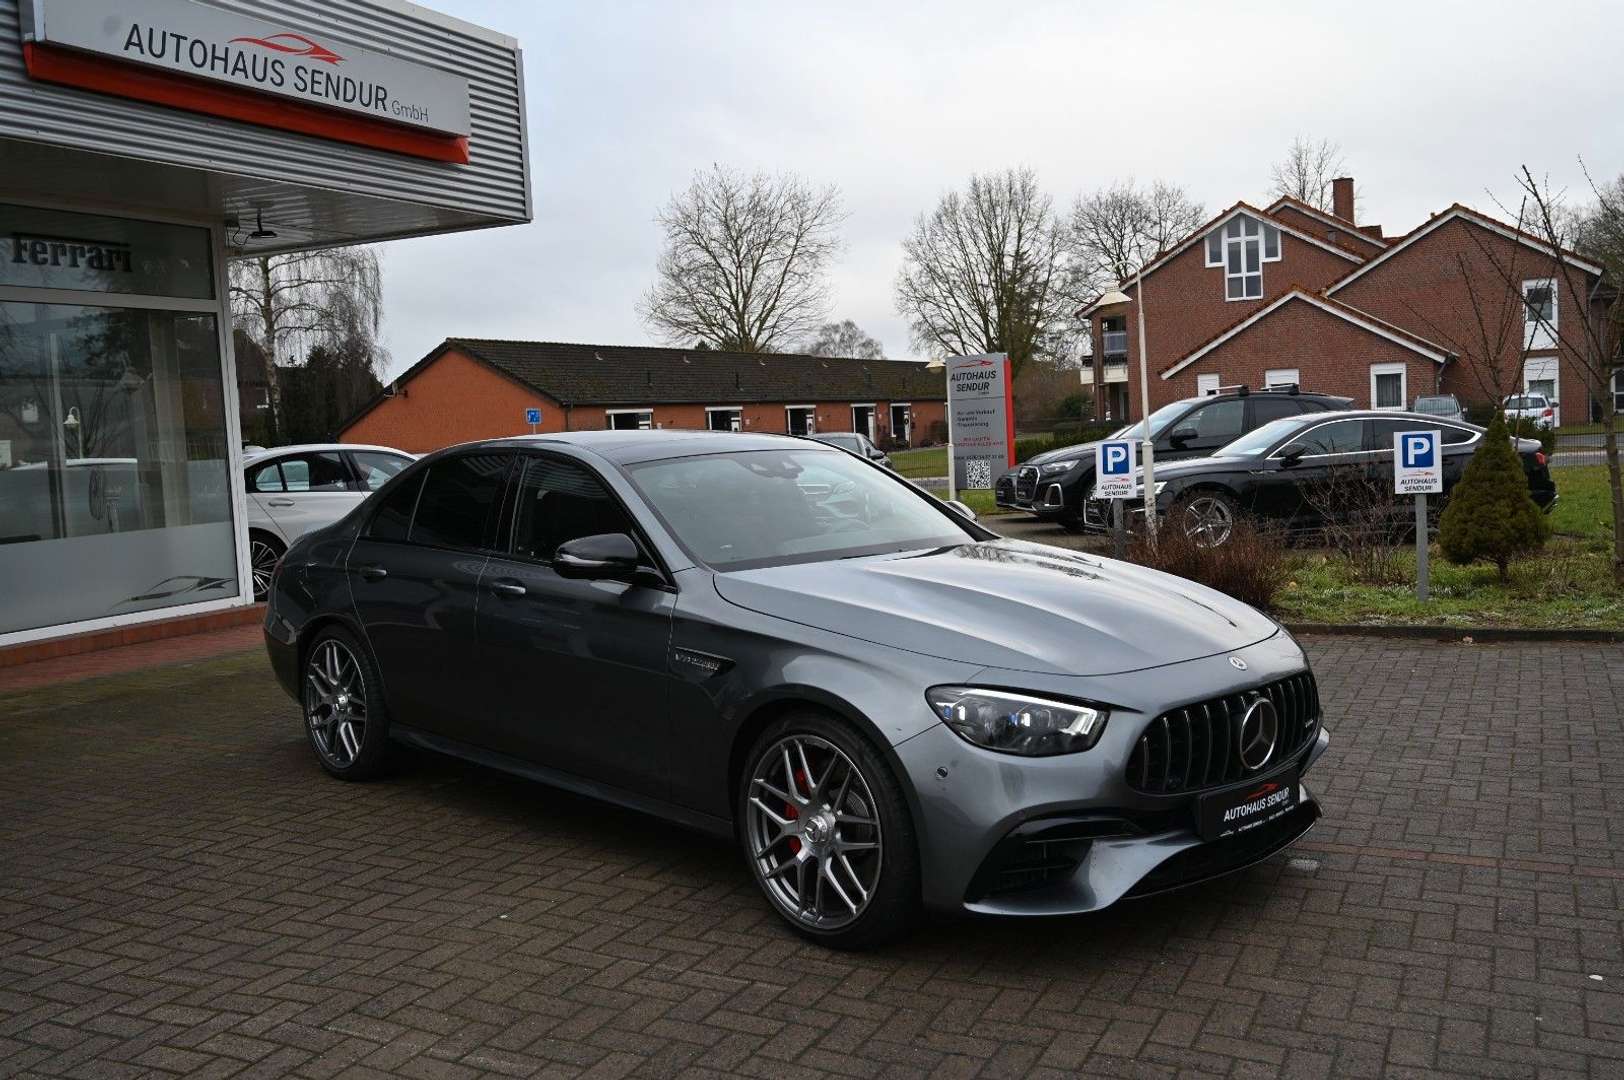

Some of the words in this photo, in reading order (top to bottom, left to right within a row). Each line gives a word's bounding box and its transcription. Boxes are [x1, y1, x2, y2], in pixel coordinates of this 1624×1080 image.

[123, 23, 285, 88] AUTOHAUS
[294, 65, 388, 112] SENDUR
[391, 100, 429, 123] GmbH
[10, 232, 132, 272] Ferrari
[951, 370, 997, 382] AUTOHAUS
[956, 381, 990, 392] SENDUR
[1101, 483, 1132, 491] AUTOHAUS
[1223, 797, 1267, 823] AUTOHAUS
[1266, 786, 1290, 808] SENDUR
